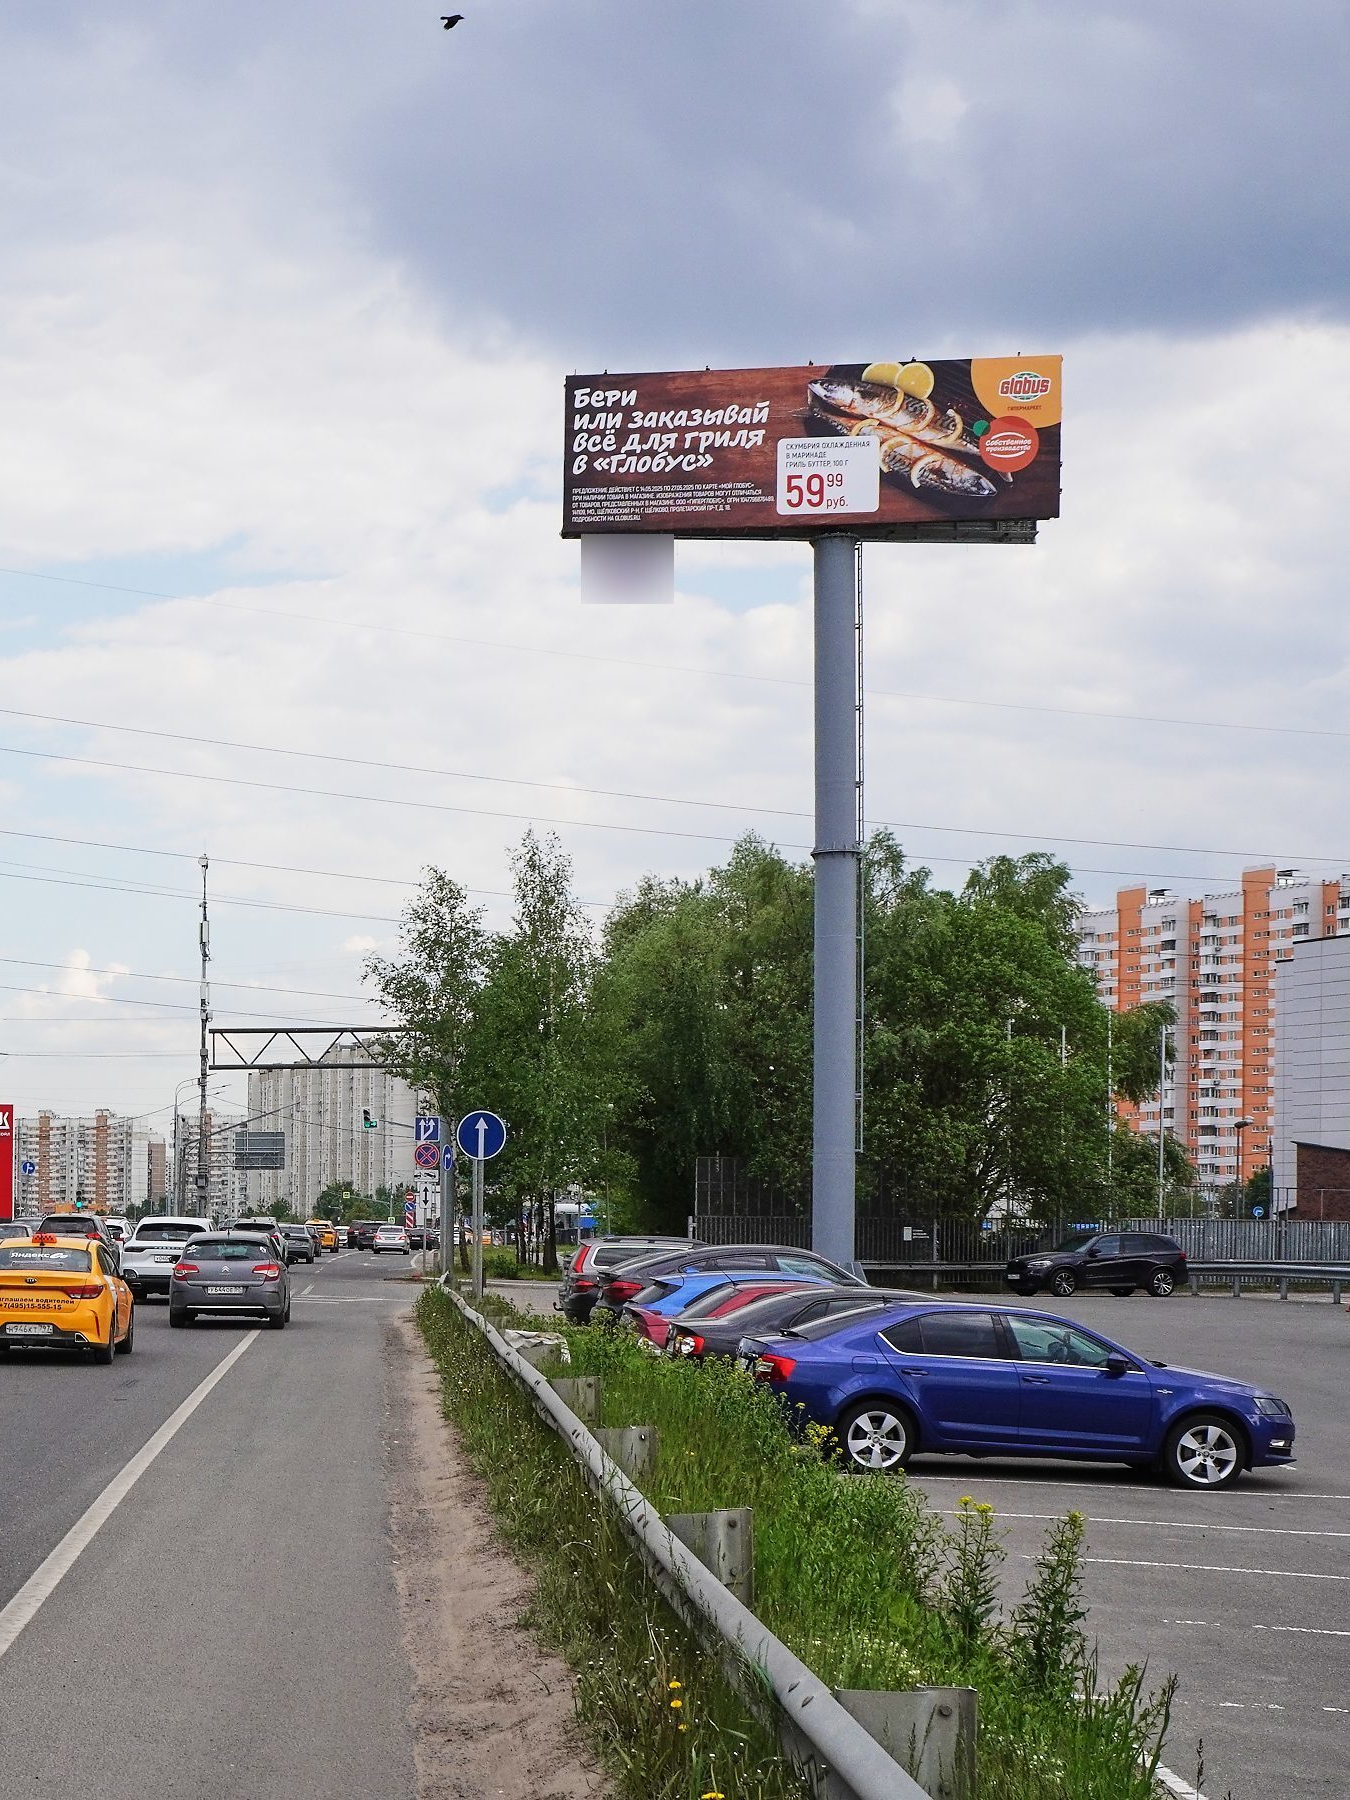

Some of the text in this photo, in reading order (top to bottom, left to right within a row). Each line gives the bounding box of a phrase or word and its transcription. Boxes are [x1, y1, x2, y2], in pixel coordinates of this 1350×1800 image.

[574, 388, 637, 408] Бери
[573, 401, 770, 430] или заказывай
[573, 429, 766, 453] всё для гриля
[822, 441, 871, 449] ОХЛАЖДЕННАЯ
[593, 452, 714, 473] «Глобус»
[808, 460, 832, 468] БУТТЕР,
[827, 473, 843, 487] 99
[786, 474, 824, 508] 59
[826, 496, 848, 509] руб.
